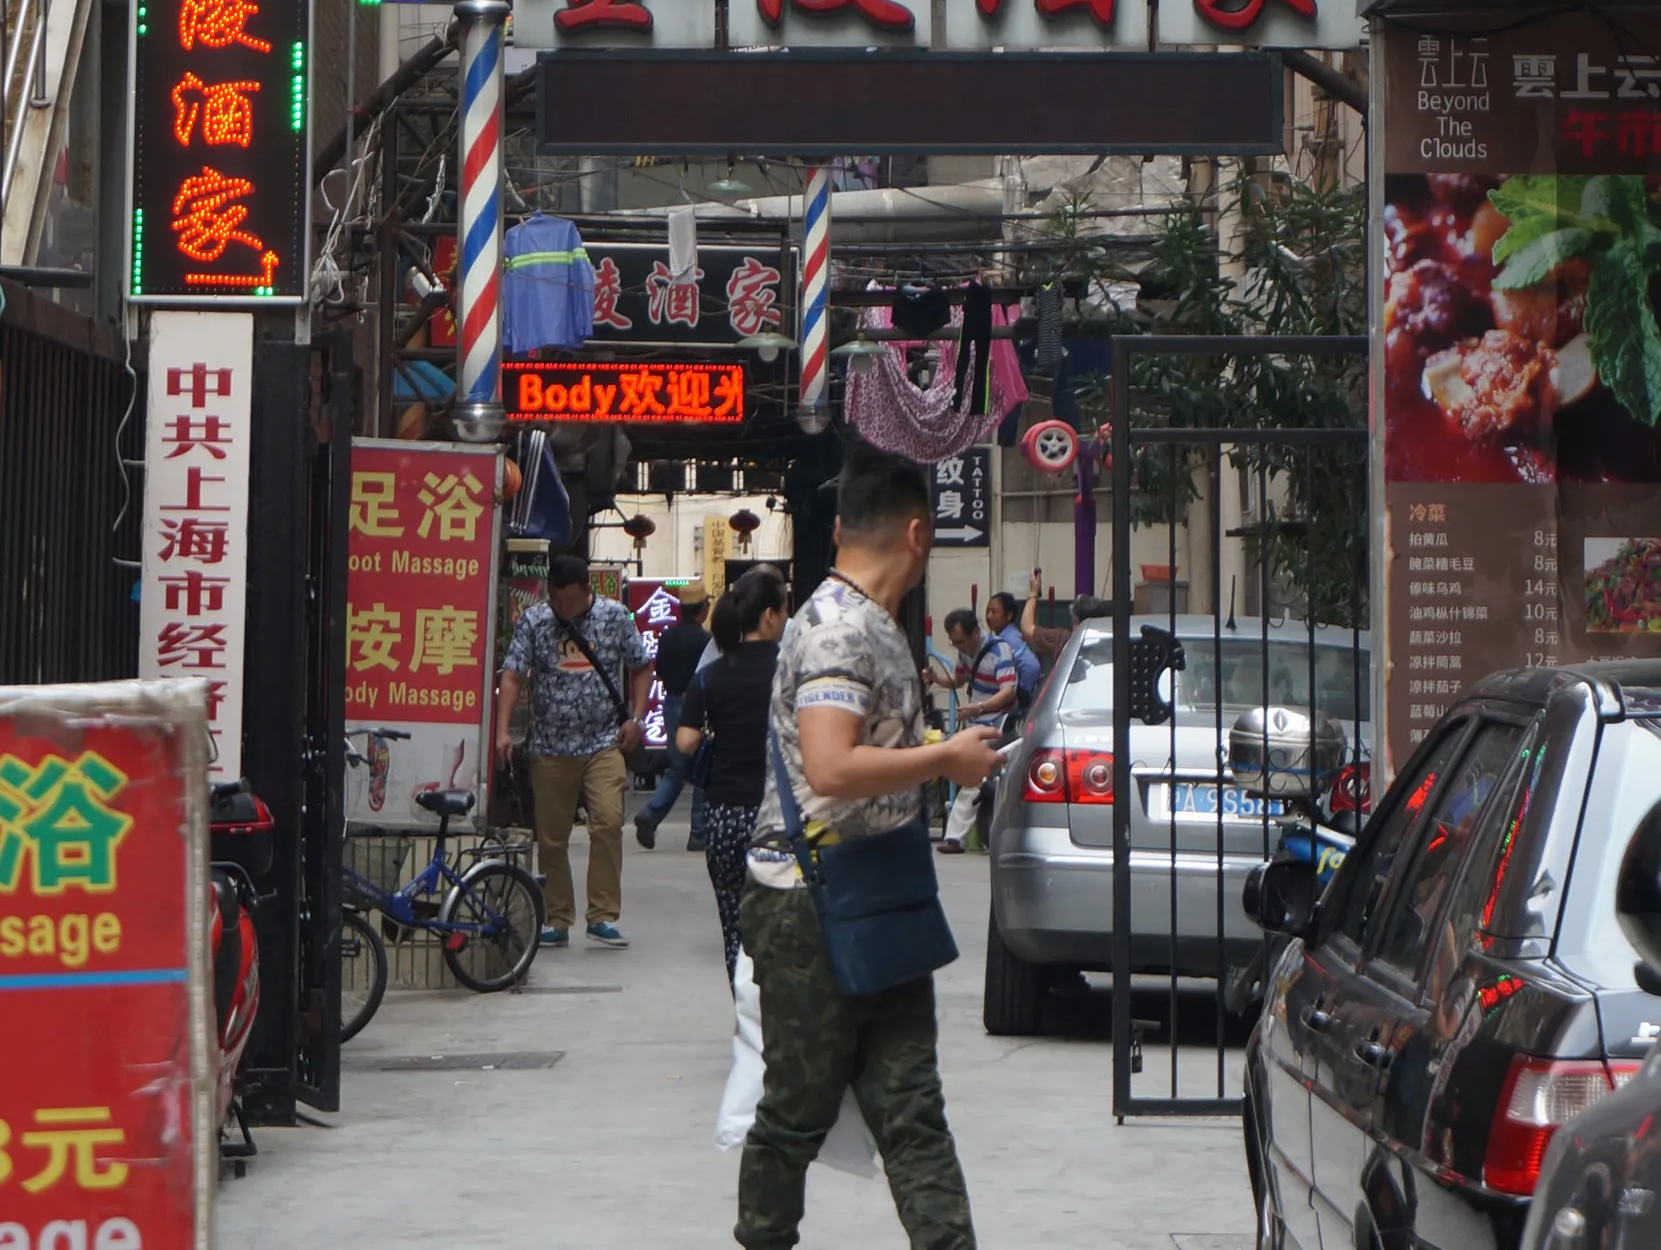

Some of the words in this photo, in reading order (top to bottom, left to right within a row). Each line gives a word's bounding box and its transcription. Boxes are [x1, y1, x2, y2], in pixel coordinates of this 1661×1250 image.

[1418, 91, 1490, 113] Beyond
[1436, 116, 1473, 136] The
[1420, 138, 1488, 158] Clouds
[936, 456, 965, 519] 纹身
[972, 456, 984, 520] TATTOO
[349, 471, 484, 541] 足浴
[1408, 503, 1446, 522] 冷菜
[1409, 532, 1449, 546] 拍黄瓜
[1534, 530, 1557, 548] 8元
[348, 551, 382, 573] oot
[391, 550, 480, 581] Massage
[1534, 554, 1558, 572] 8元
[1524, 578, 1557, 596] 14元
[1524, 603, 1558, 621] 10元
[345, 602, 478, 675] 按摩
[1409, 630, 1463, 645] 蔬菜沙拉
[1534, 628, 1559, 646] 8元
[345, 680, 379, 709] ody
[388, 681, 476, 712] Massage
[1409, 703, 1450, 719] 蓝莓山
